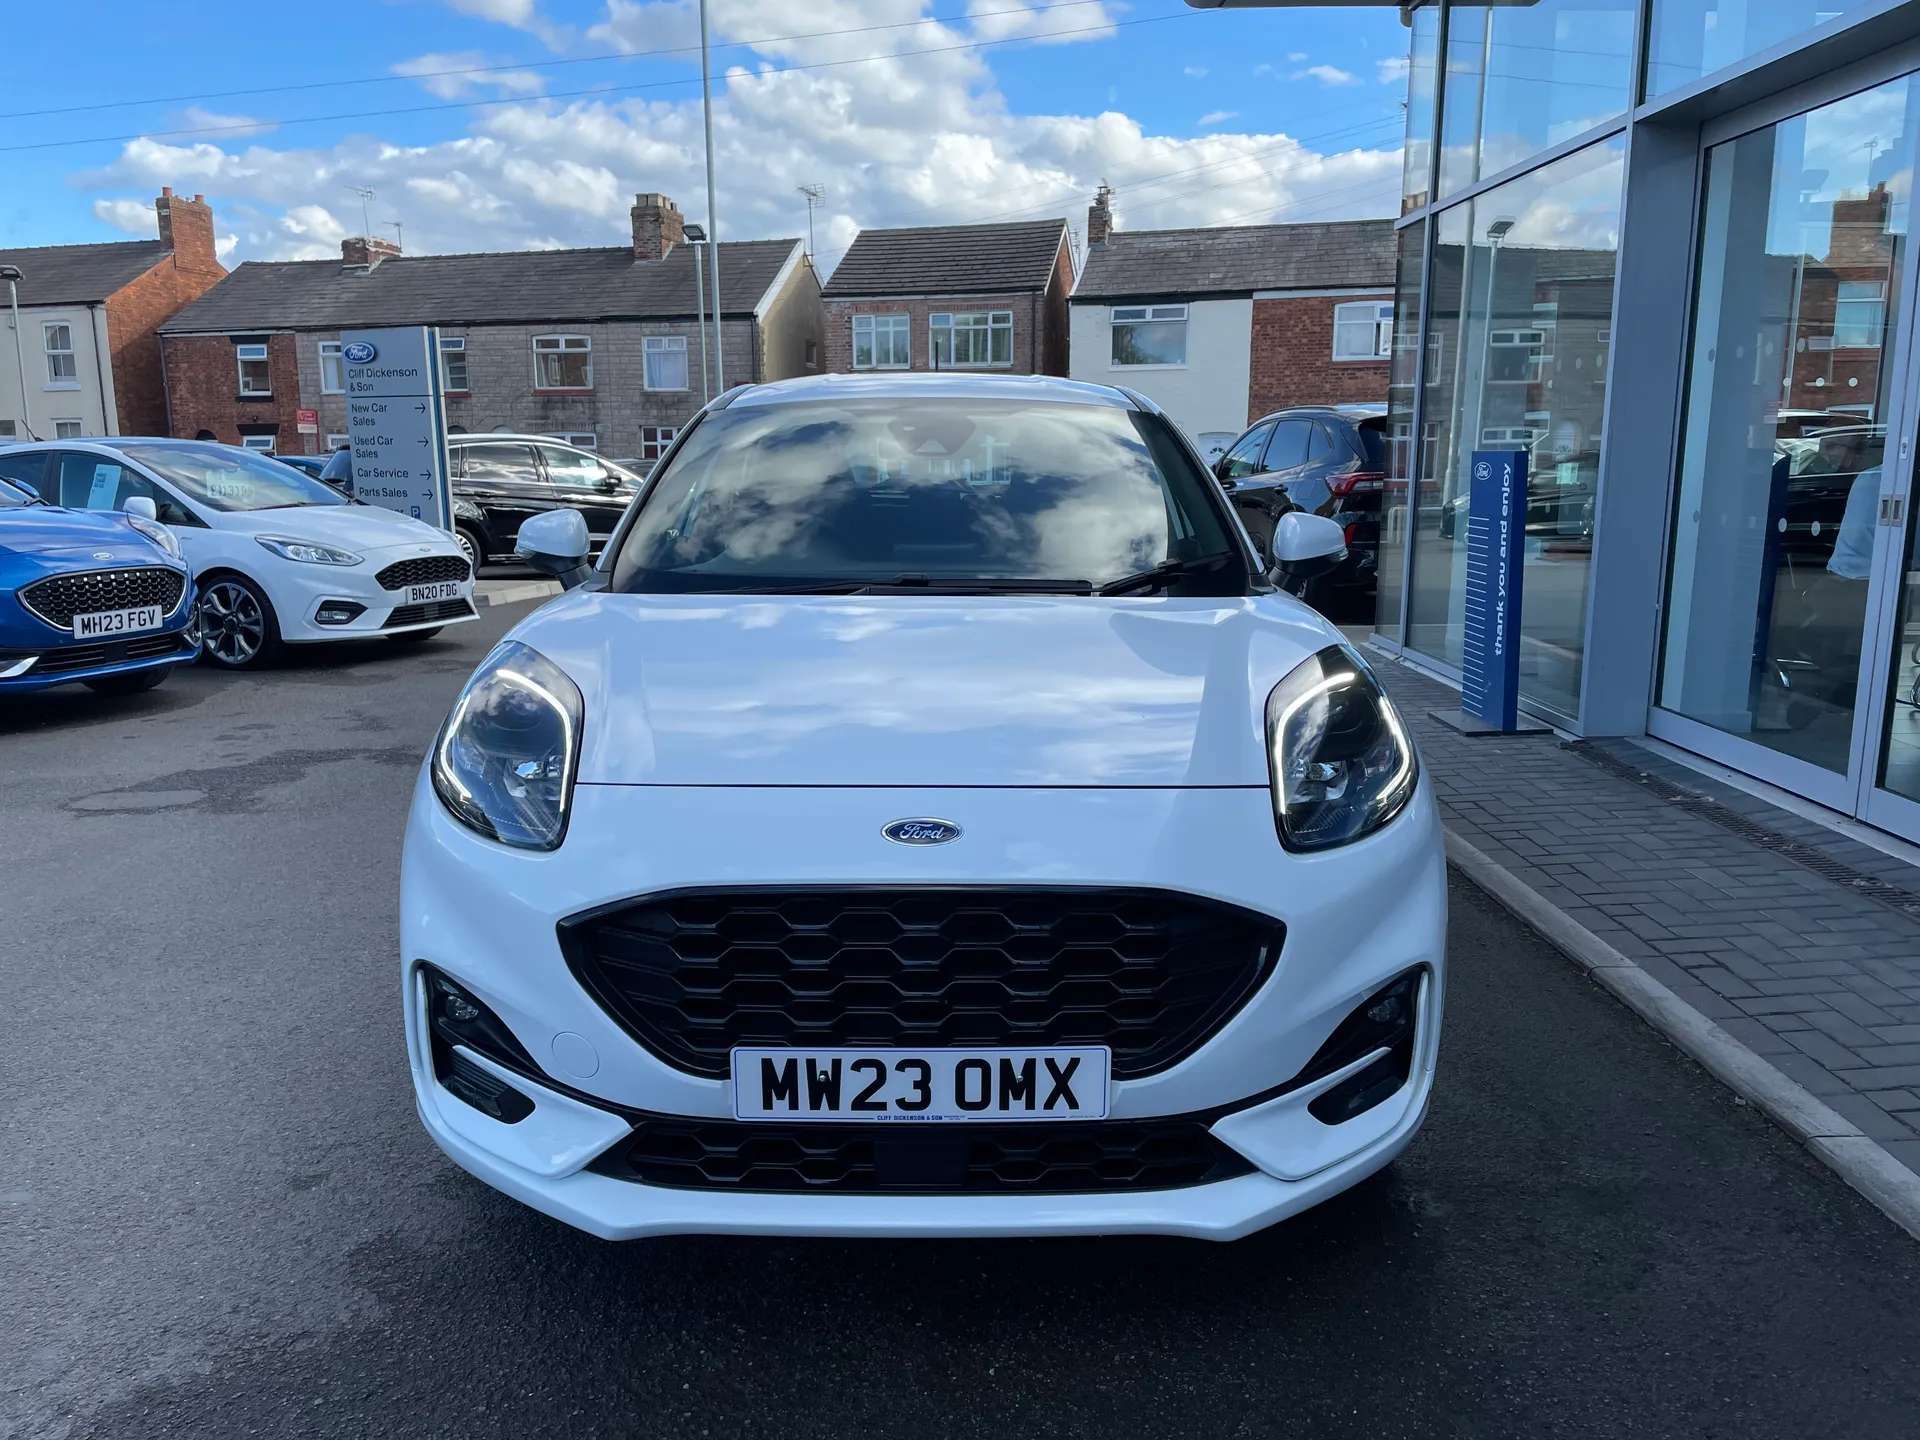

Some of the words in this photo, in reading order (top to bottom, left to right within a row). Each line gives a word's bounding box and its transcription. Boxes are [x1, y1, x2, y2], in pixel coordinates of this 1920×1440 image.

[348, 345, 368, 359] Ford
[348, 368, 365, 379] Cliff
[366, 367, 418, 378] Dickenson
[350, 383, 356, 392] &
[357, 382, 374, 392] Son
[351, 403, 370, 413] New
[371, 403, 388, 413] Car
[353, 416, 375, 426] Sales
[354, 436, 376, 446] Used
[377, 436, 394, 445] Car
[355, 448, 378, 459] Sales
[357, 468, 372, 478] Car
[373, 468, 409, 478] Service
[359, 487, 381, 497] Parts
[382, 487, 408, 498] Sales
[1501, 462, 1511, 517] enjoy
[1499, 520, 1508, 558] and
[1498, 562, 1506, 597] you
[411, 585, 438, 601] BN20
[439, 583, 457, 597] FDG
[81, 614, 124, 634] MH23
[128, 609, 155, 628] FGV
[1495, 601, 1504, 656] thank
[899, 823, 944, 839] Ford
[761, 1057, 932, 1111] MW23
[955, 1057, 1082, 1111] OMX
